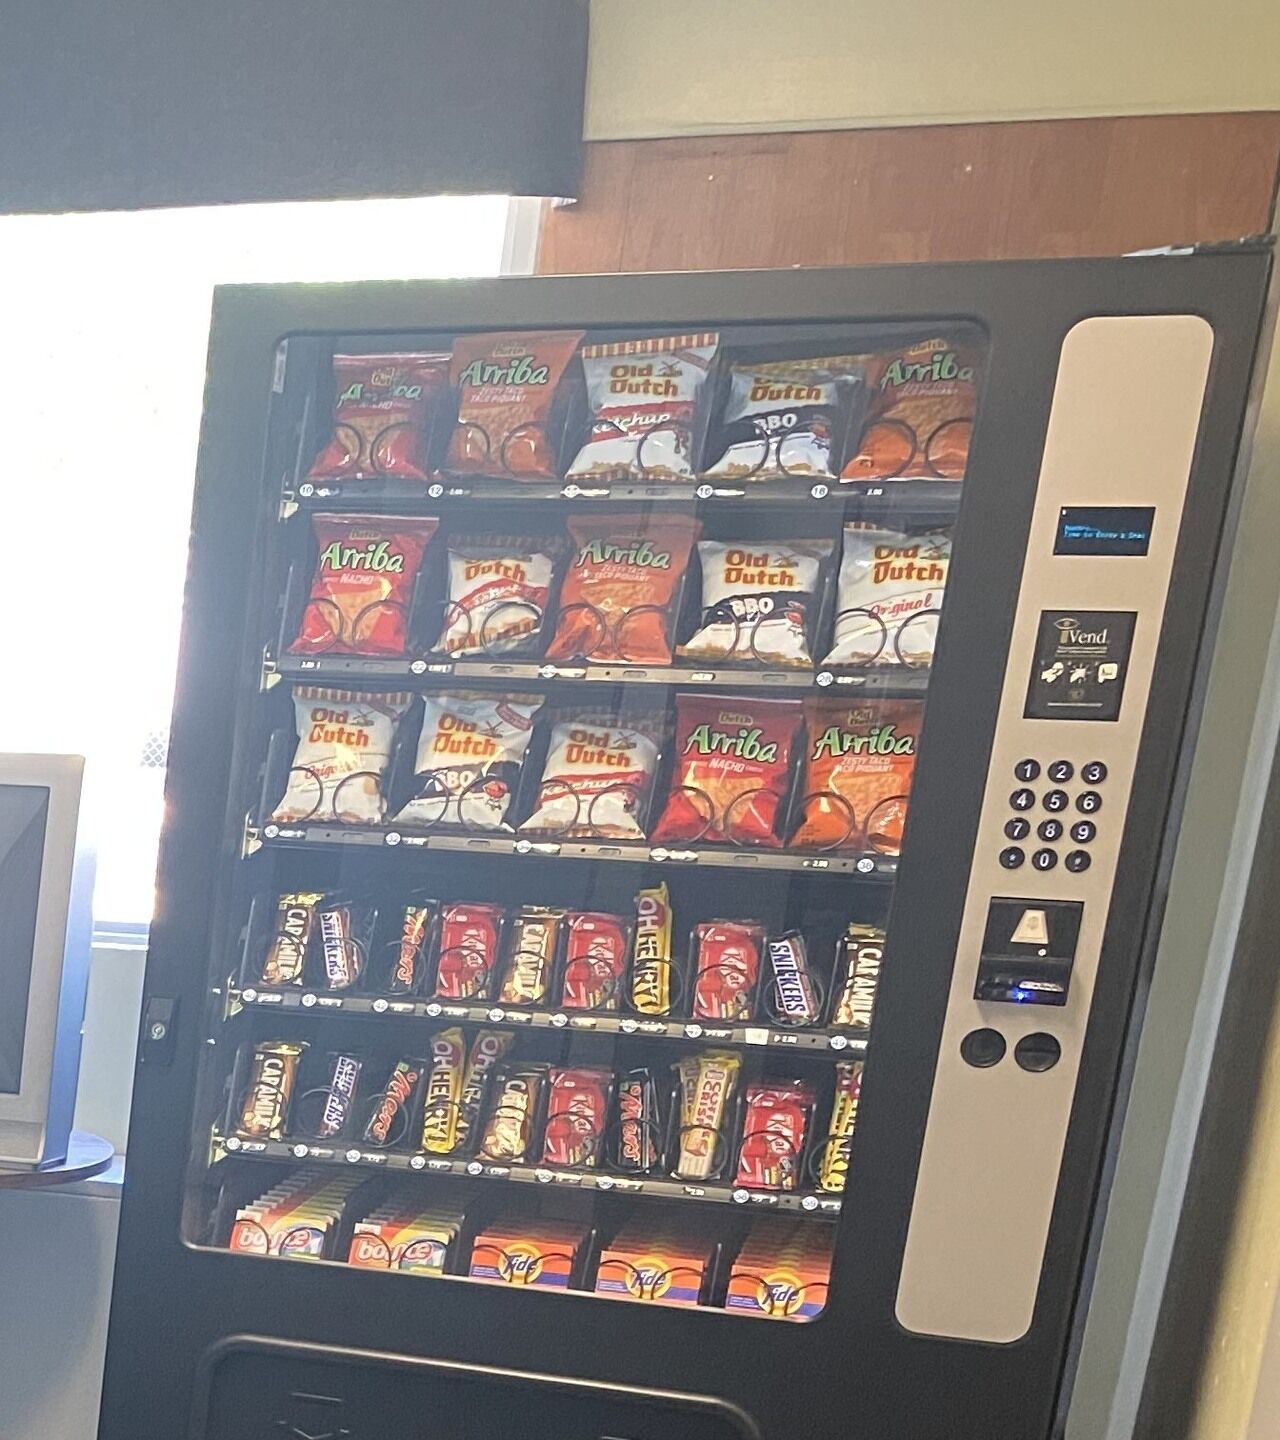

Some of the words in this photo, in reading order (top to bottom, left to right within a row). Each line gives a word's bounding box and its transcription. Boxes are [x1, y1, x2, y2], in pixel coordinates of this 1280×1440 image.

[459, 356, 548, 386] Arriba
[610, 364, 653, 378] Old
[880, 352, 977, 393] Arriba
[610, 379, 679, 397] Dutch
[751, 385, 822, 402] Dutch
[320, 541, 404, 573] Arriba
[576, 540, 671, 569] Arriba
[725, 549, 770, 567] Old
[465, 561, 526, 582] Dutch
[725, 567, 794, 587] Dutch
[874, 561, 944, 584] Dutch
[869, 592, 933, 618] Original
[310, 707, 350, 724] Old
[438, 712, 478, 733] Old
[309, 724, 369, 747] Dutch
[433, 733, 497, 756] Dutch
[569, 730, 611, 748] Old
[682, 724, 778, 763] Arriba
[812, 725, 914, 760] Arriba
[566, 743, 631, 768] Dutch
[708, 758, 746, 773] NACHO
[1024, 763, 1032, 778] 1
[1056, 765, 1067, 779] 2
[1088, 766, 1100, 780] 3
[1016, 793, 1027, 807] 4
[1049, 794, 1060, 809] 5
[1083, 796, 1094, 810] 6
[1013, 822, 1022, 837] 7
[1045, 823, 1056, 838] 8
[1077, 825, 1089, 840] 9
[1039, 853, 1049, 867] 0
[770, 943, 807, 1012] SNICKERS
[373, 1070, 412, 1142] Mars
[620, 1091, 642, 1162] Mars
